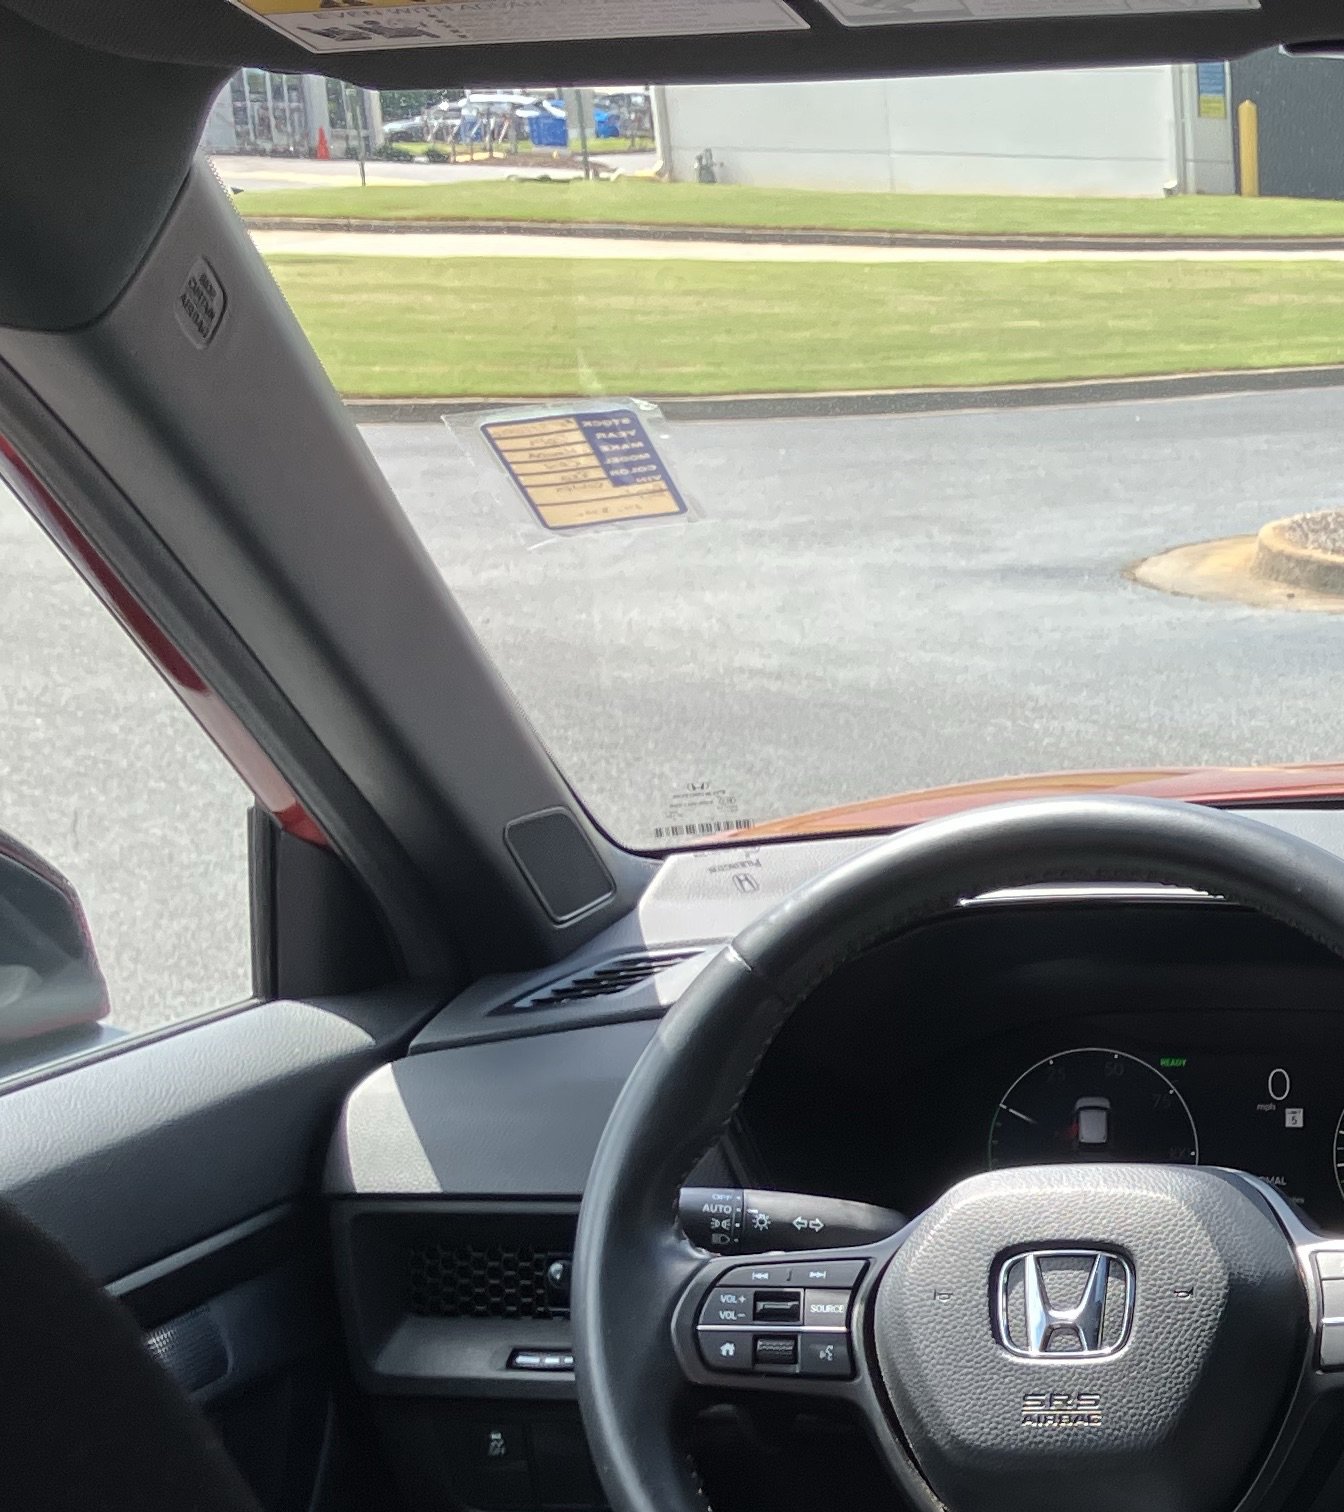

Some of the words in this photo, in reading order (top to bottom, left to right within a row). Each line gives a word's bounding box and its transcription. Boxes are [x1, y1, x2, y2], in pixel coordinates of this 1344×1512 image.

[1160, 1058, 1187, 1067] READY
[1104, 1062, 1125, 1077] 50
[1268, 1068, 1290, 1101] 0
[1152, 1094, 1171, 1108] 75
[1257, 1103, 1276, 1112] mph
[1291, 1115, 1298, 1126] 5
[702, 1203, 733, 1214] AUTO
[810, 1304, 845, 1314] SOURCE
[1022, 1393, 1101, 1410] SRS
[1022, 1413, 1102, 1427] AIRBAG
